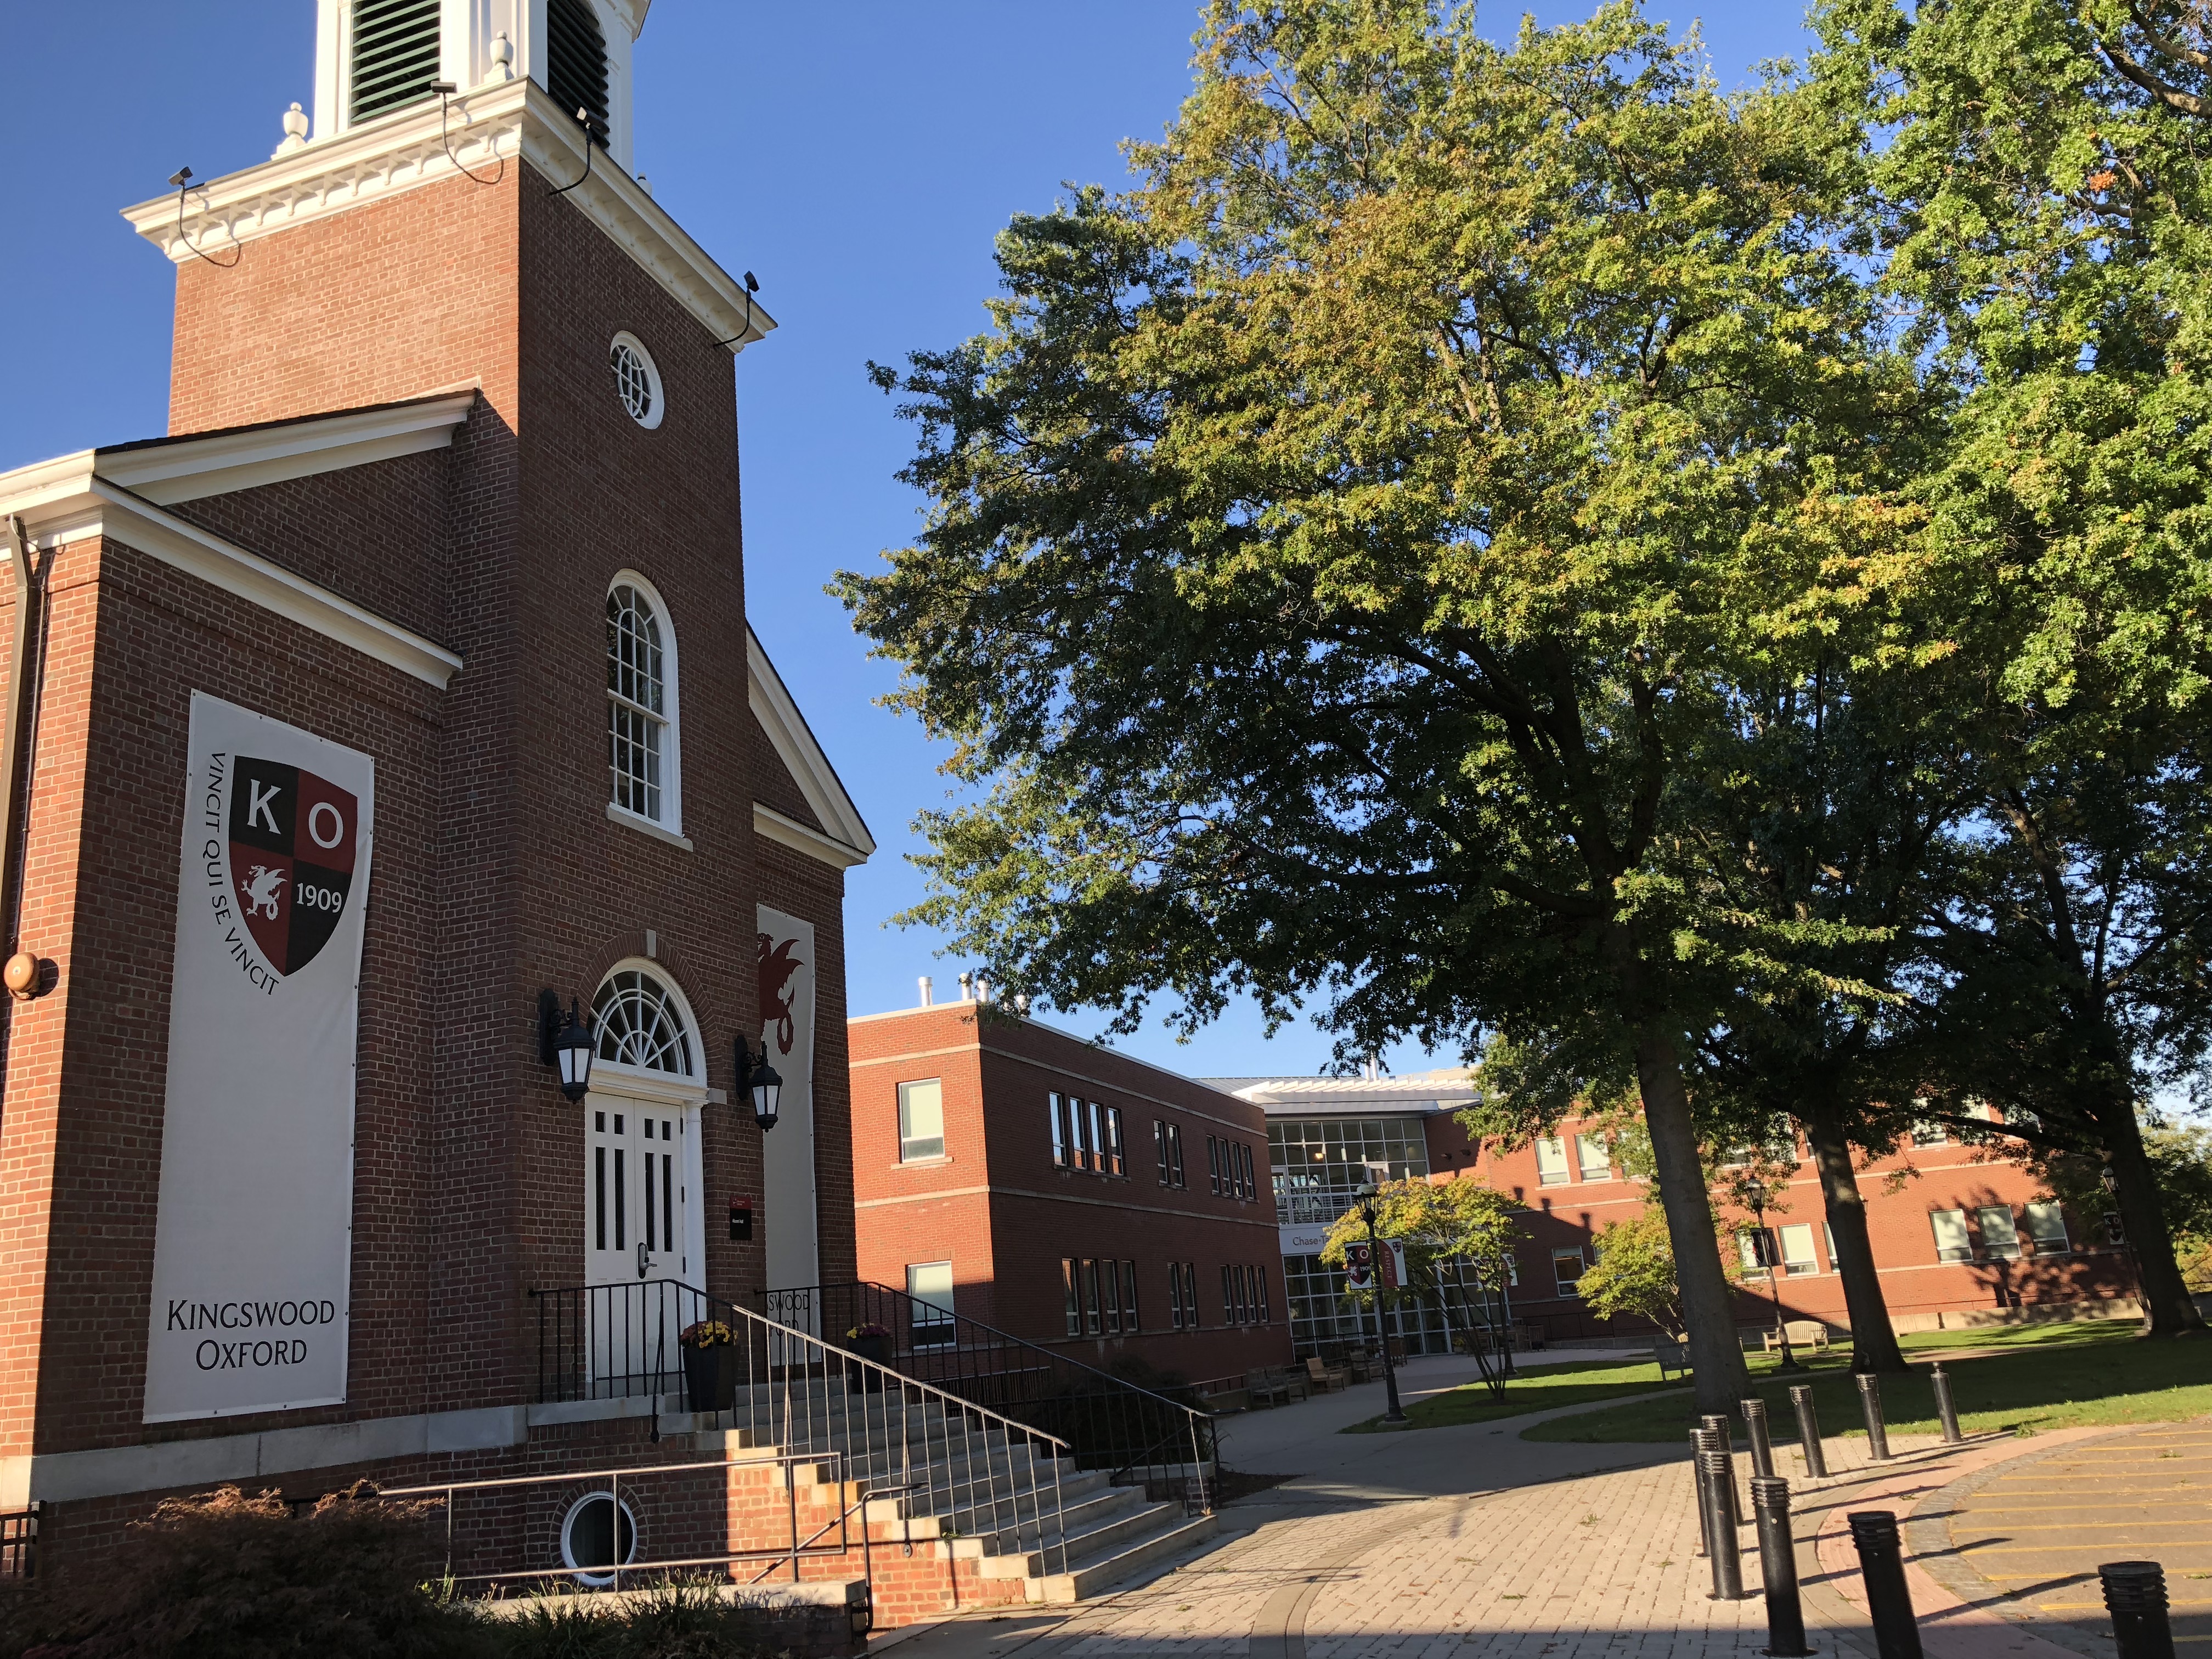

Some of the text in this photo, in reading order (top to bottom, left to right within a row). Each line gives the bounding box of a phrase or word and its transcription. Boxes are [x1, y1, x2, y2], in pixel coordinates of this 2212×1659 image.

[202, 752, 279, 996] VINCIT QUI SE VINCIT
[296, 882, 342, 913] 1909
[1384, 1251, 1393, 1279] RESPECT
[167, 1300, 335, 1331] KINGSWOOD
[769, 1294, 810, 1311] SWOOD
[196, 1339, 307, 1370] OXFORD
